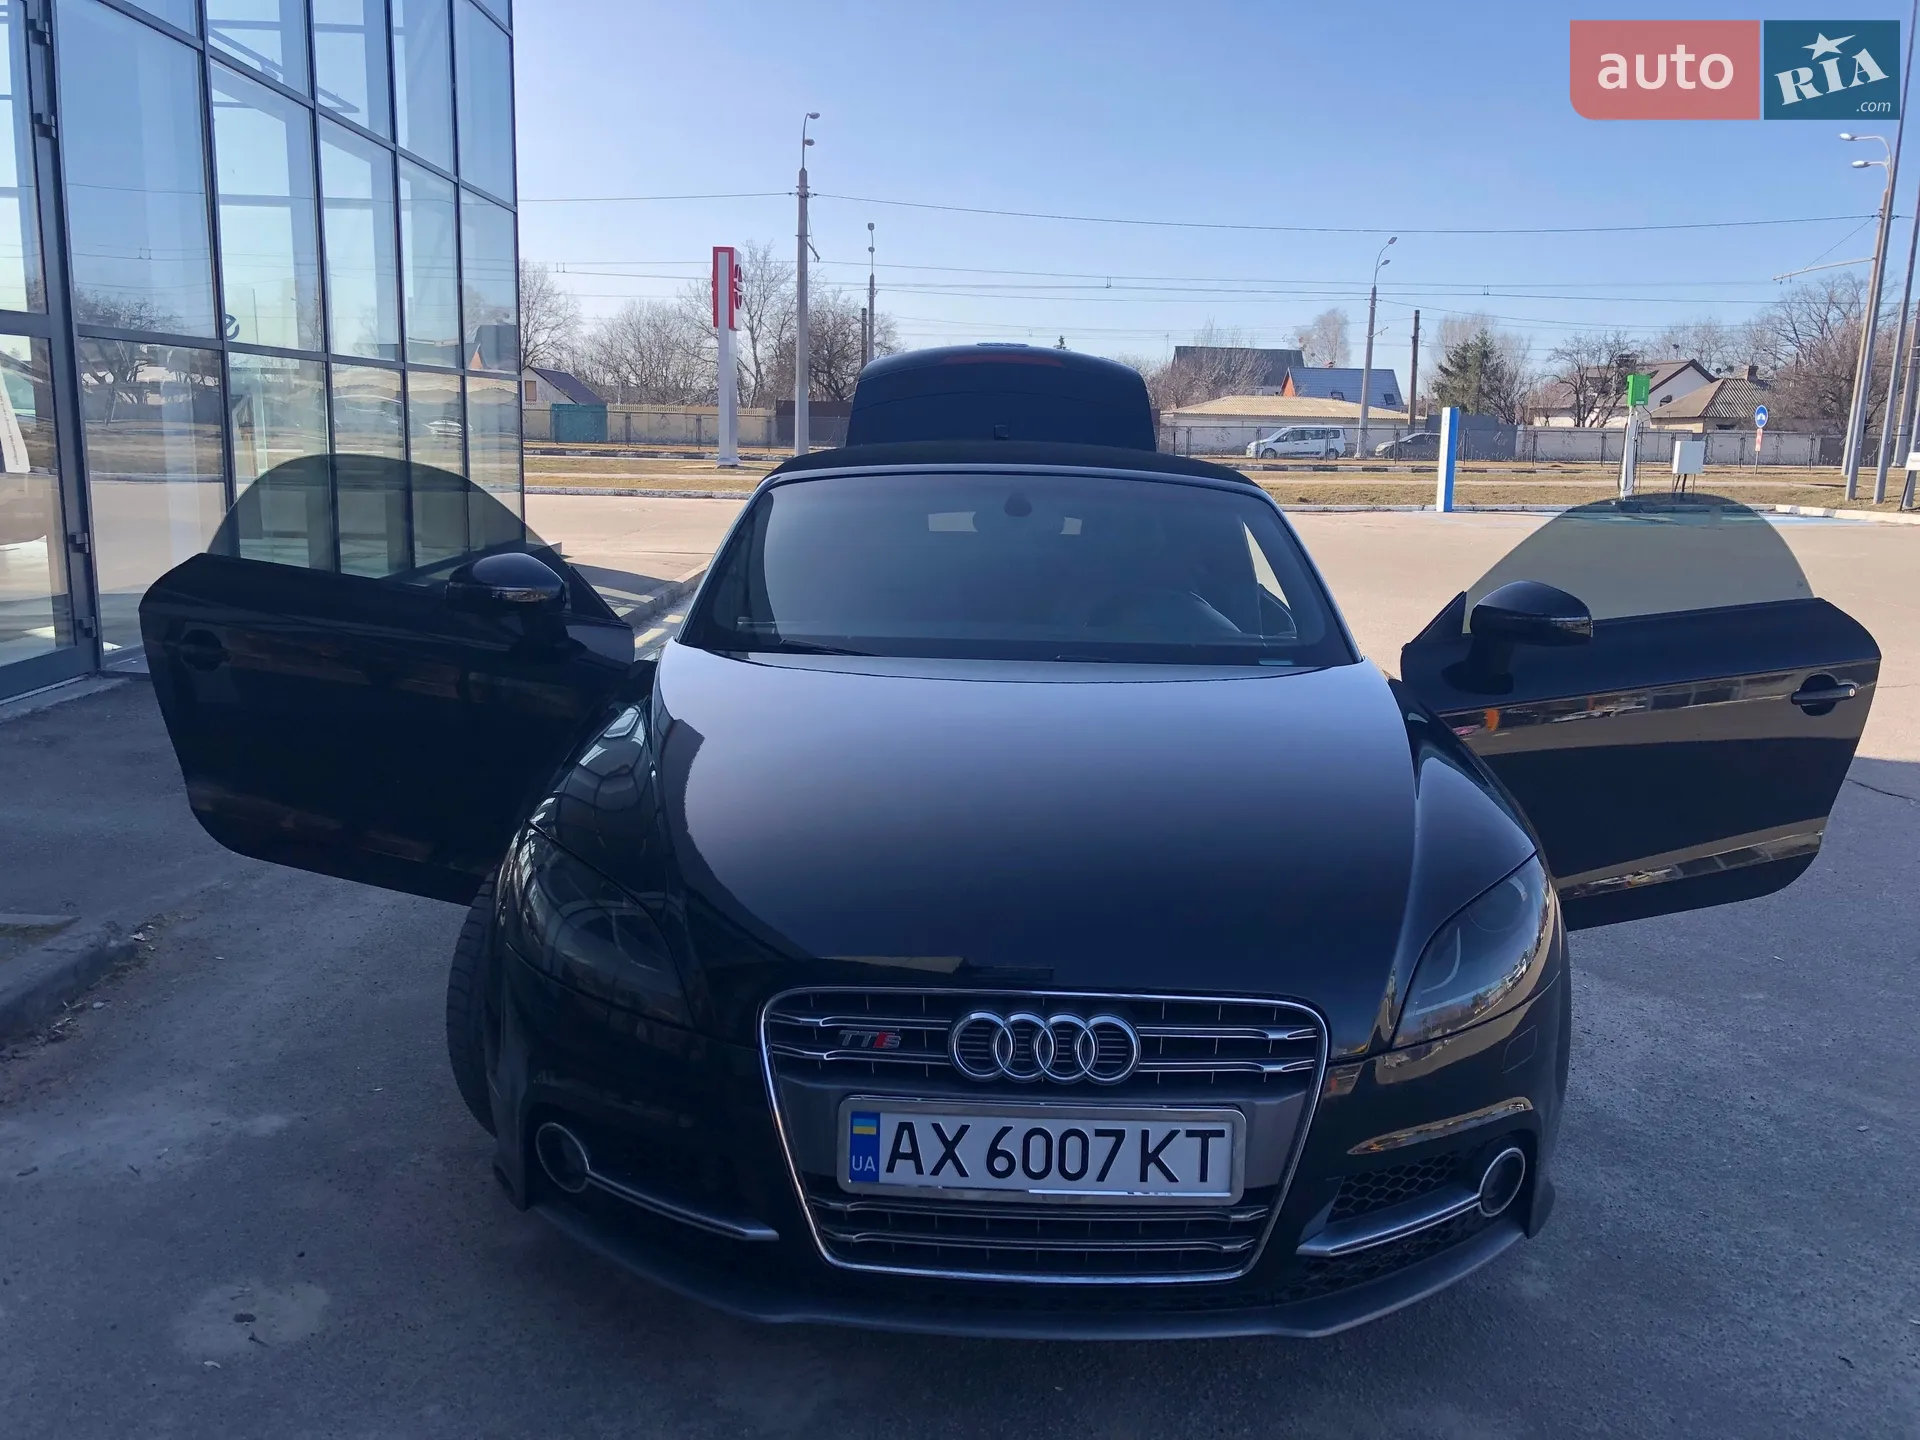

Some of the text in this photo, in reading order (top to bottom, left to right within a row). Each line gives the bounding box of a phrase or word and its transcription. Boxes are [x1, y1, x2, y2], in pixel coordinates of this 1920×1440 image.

[839, 1029, 902, 1049] TTS
[886, 1121, 1226, 1183] AX 6007 KT
[851, 1155, 876, 1172] UA
